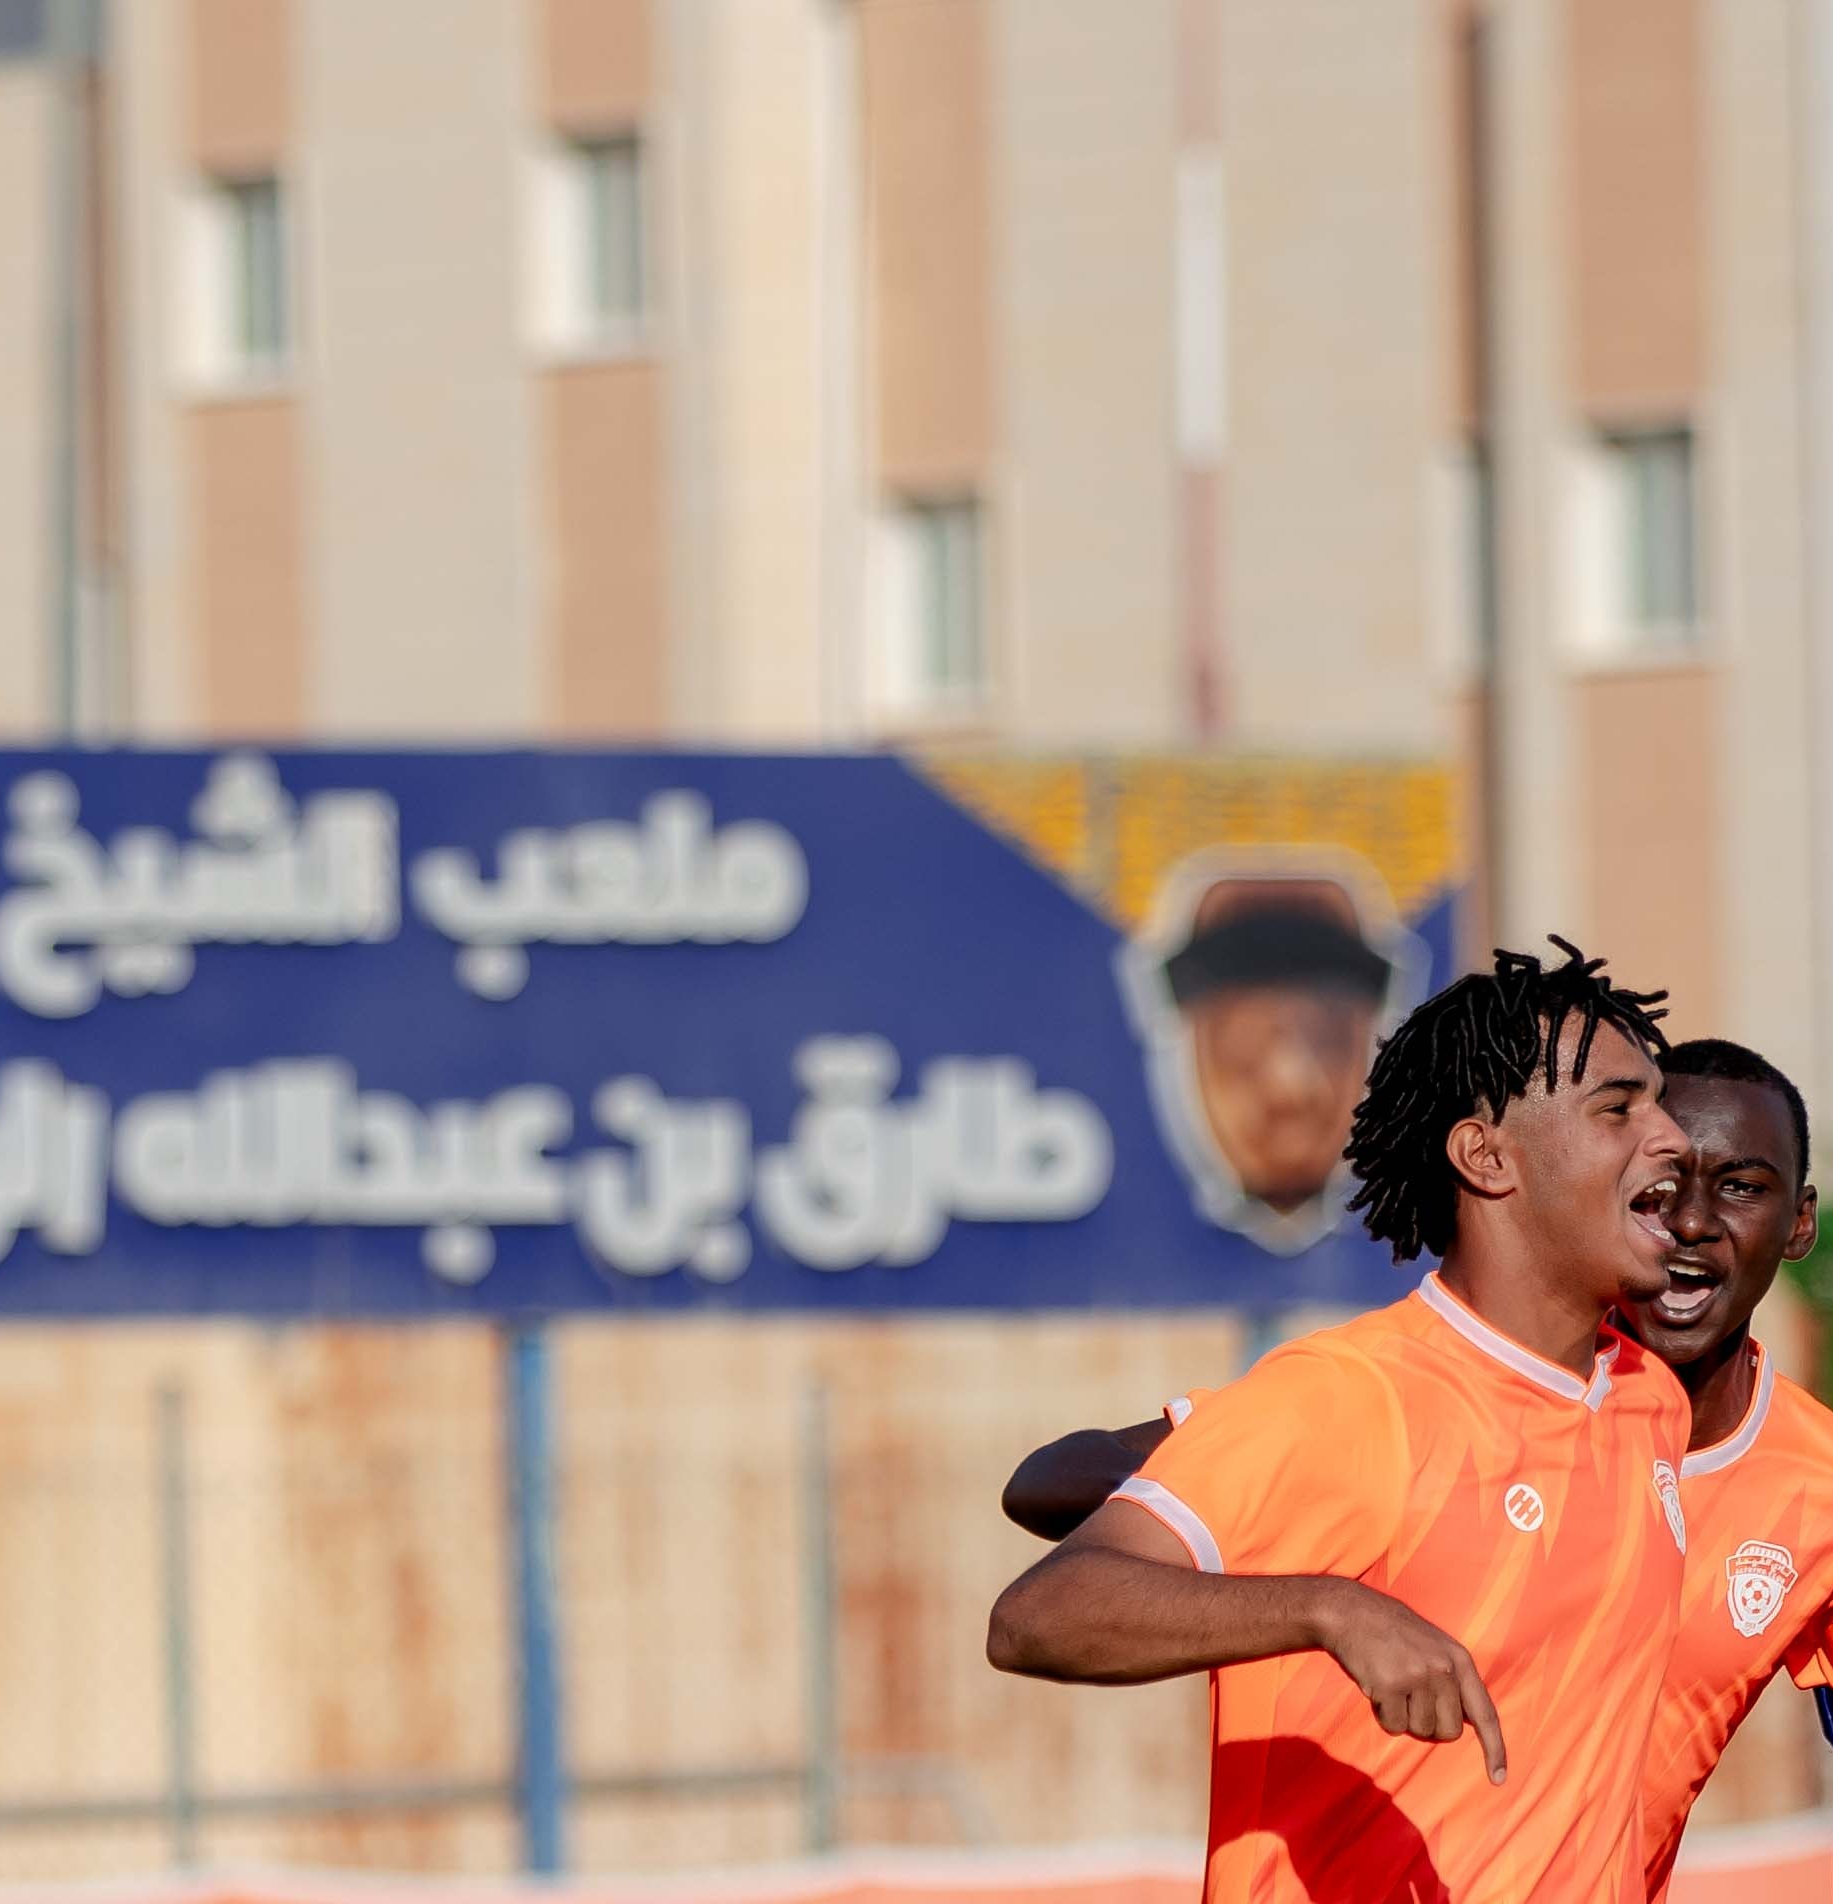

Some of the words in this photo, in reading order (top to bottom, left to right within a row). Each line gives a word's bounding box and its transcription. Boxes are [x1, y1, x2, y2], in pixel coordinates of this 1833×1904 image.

[414, 792, 807, 999] ملعب
[112, 1056, 574, 1284] عبدالله
[570, 1075, 754, 1281] بن
[762, 1036, 1111, 1271] طارق
